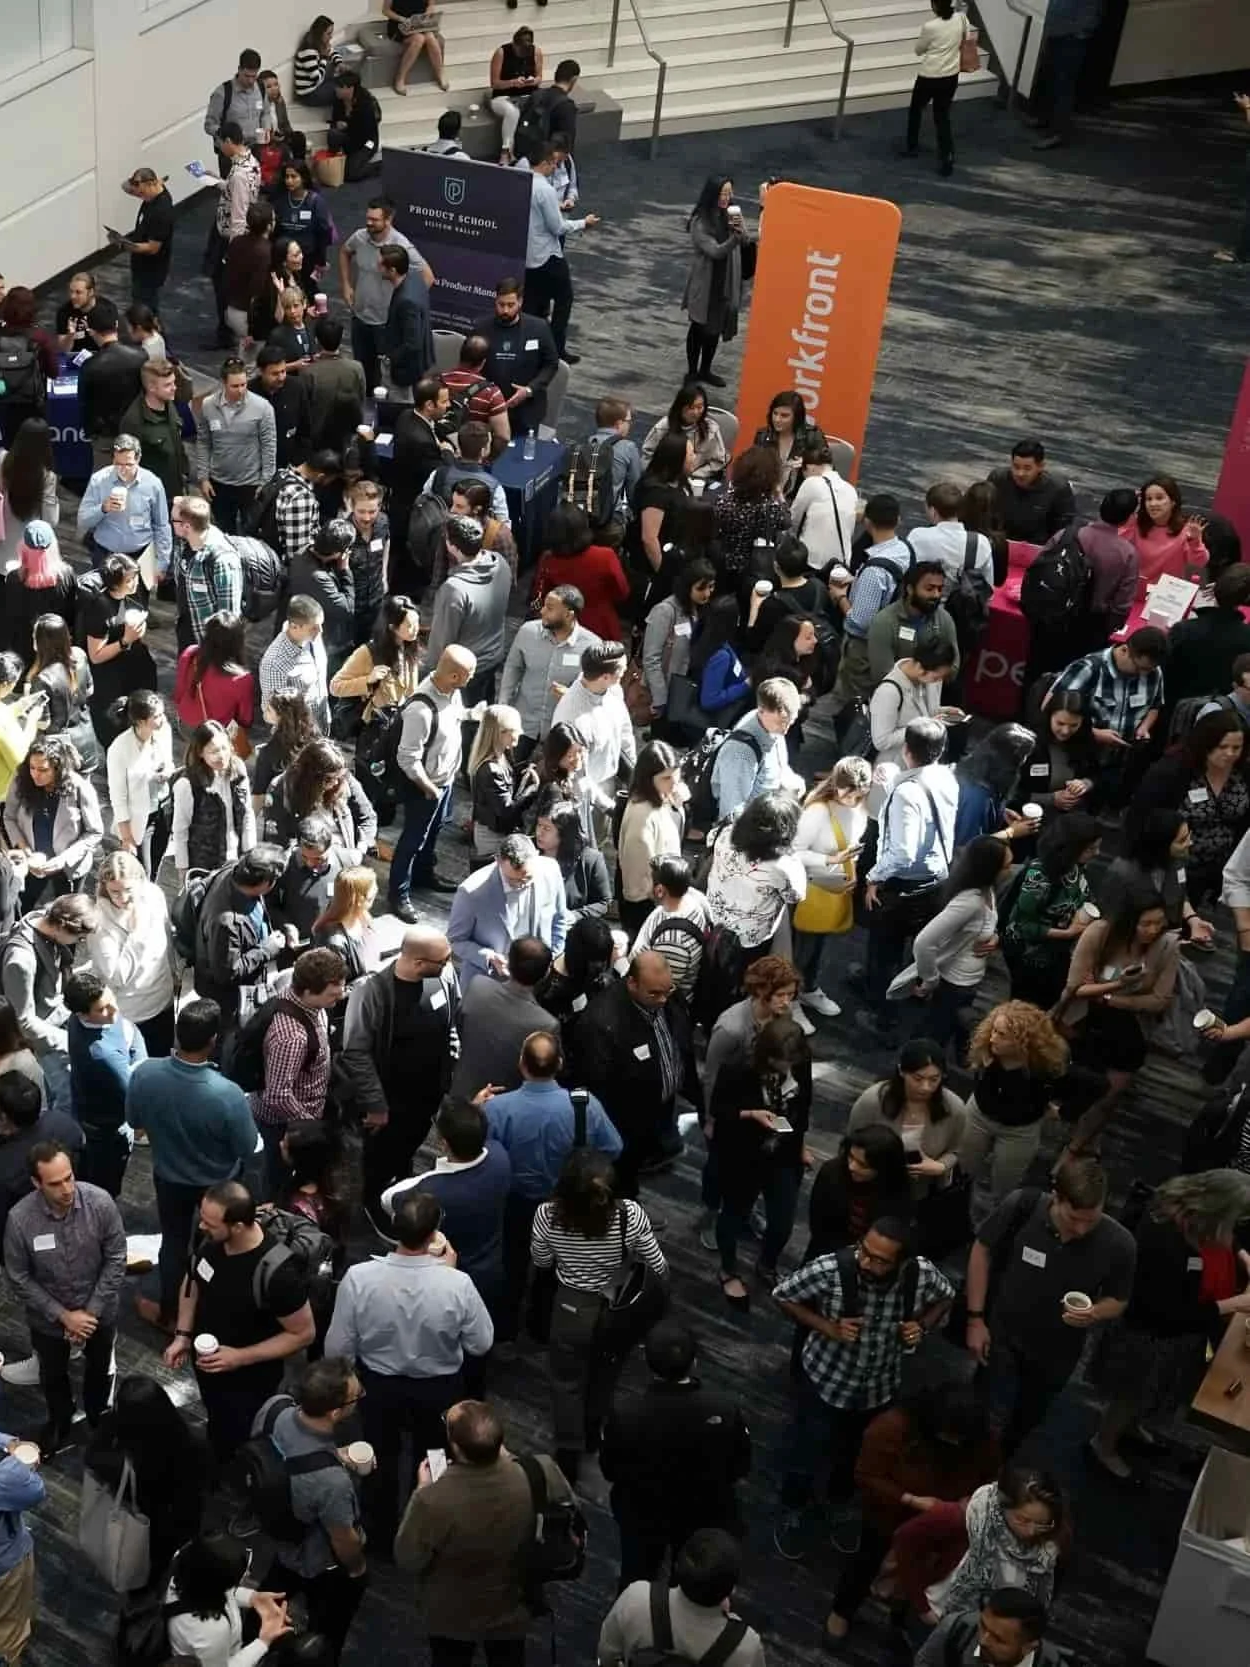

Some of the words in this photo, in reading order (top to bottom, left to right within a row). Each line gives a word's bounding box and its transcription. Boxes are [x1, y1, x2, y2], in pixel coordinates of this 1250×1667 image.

[409, 205, 455, 221] PRODUCT
[458, 214, 498, 229] SCHOOL
[455, 226, 480, 236] VALLEY
[788, 250, 841, 425] orkfront
